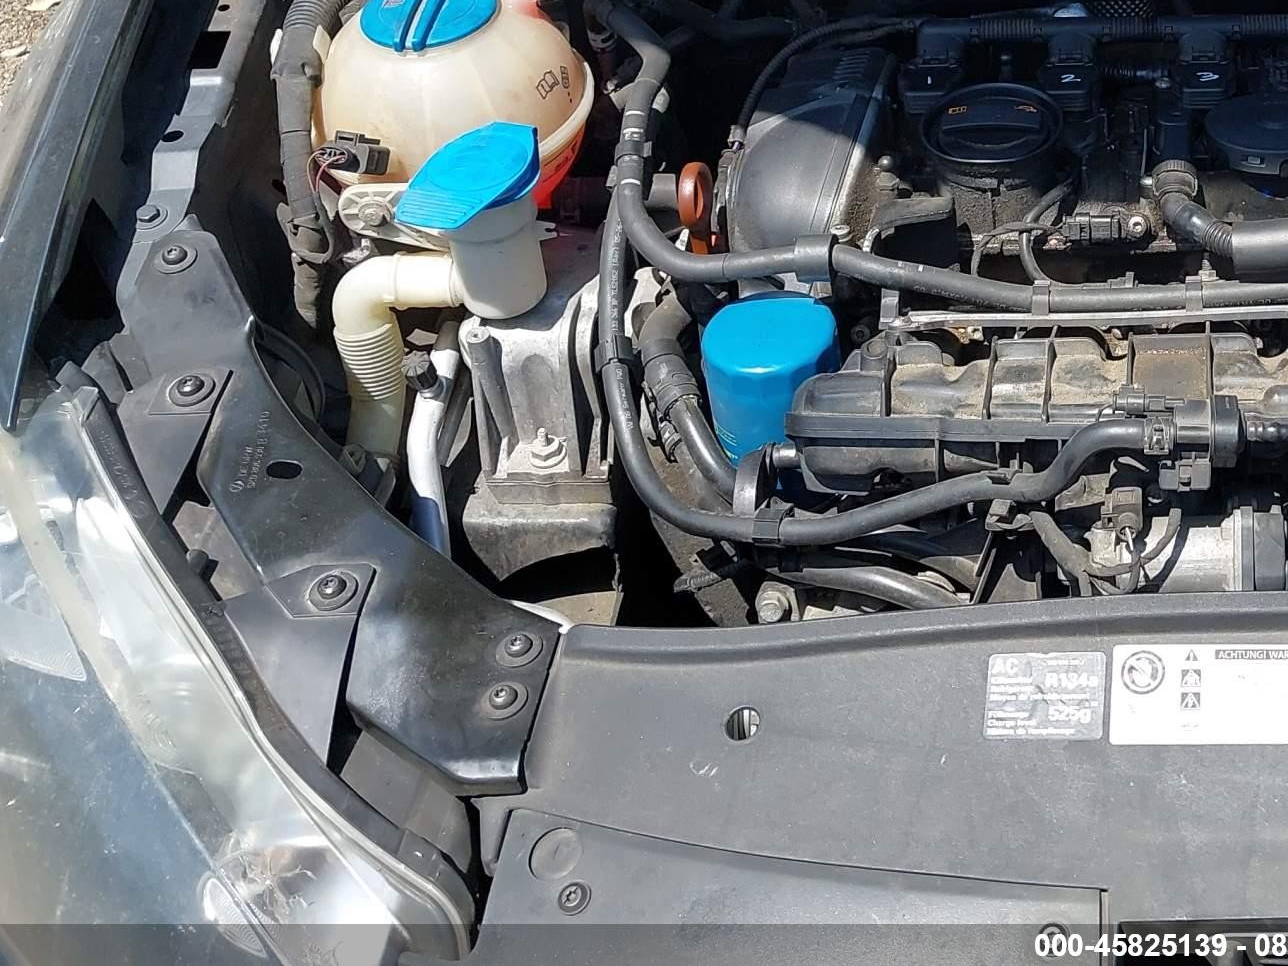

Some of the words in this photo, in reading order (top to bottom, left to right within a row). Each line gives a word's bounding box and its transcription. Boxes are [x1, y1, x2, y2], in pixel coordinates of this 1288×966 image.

[1060, 73, 1082, 83] 2
[1196, 70, 1219, 82] 3
[1218, 648, 1267, 660] ACHTUNG!
[991, 657, 1020, 676] AC
